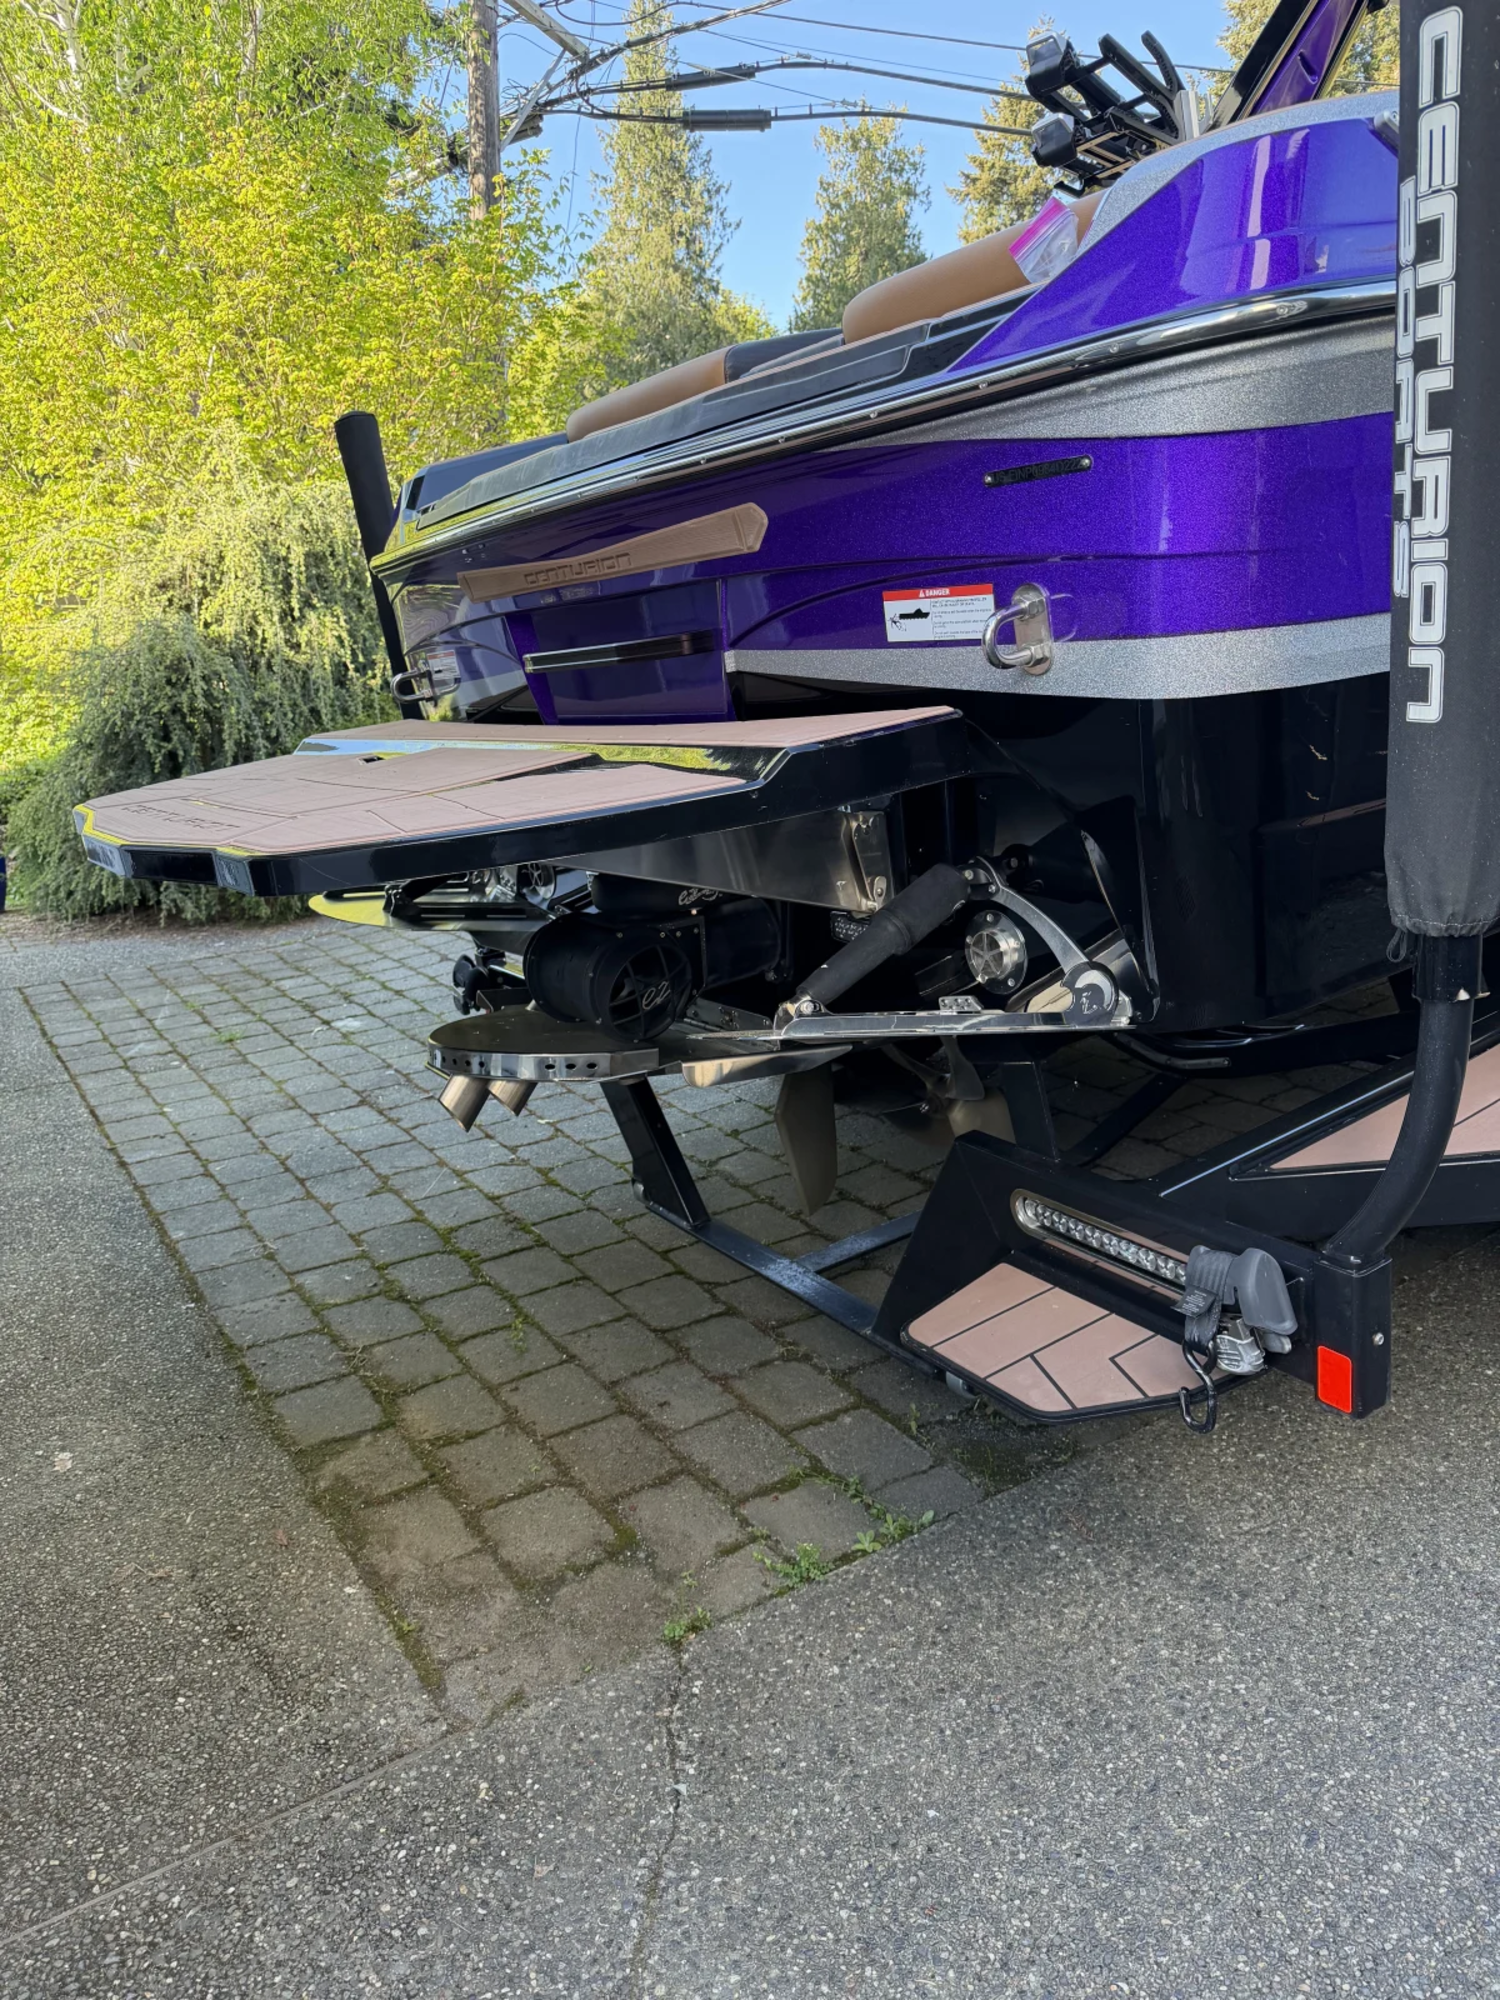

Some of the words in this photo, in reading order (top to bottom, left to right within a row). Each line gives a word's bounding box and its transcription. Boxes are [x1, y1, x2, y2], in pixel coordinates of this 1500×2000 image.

[1393, 174, 1417, 599] BOATS
[1406, 5, 1463, 725] CENTURION
[523, 552, 632, 586] CENTURION
[925, 587, 950, 597] DANGER
